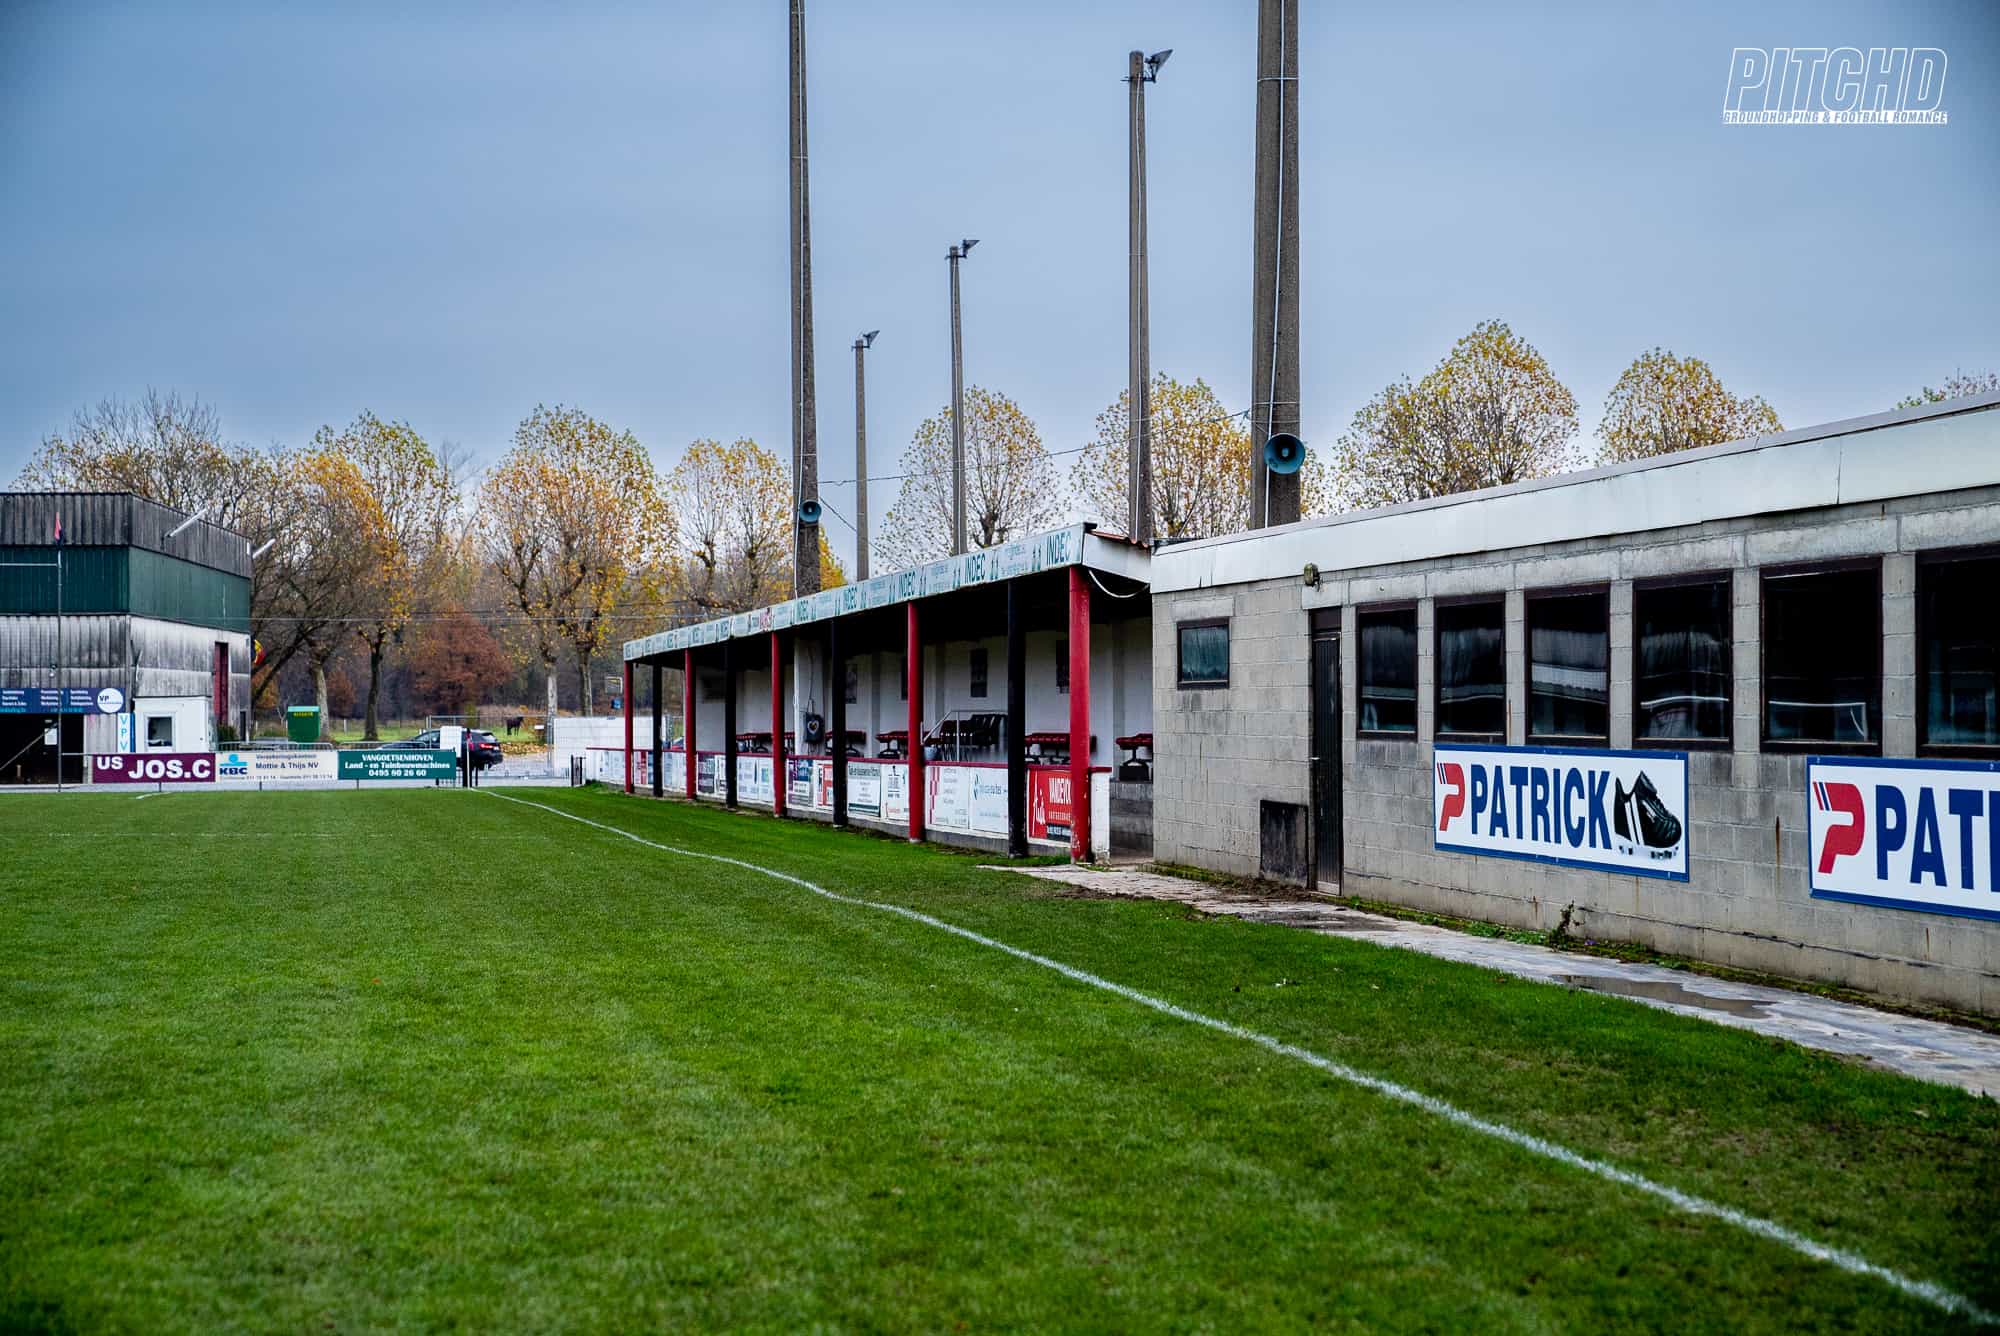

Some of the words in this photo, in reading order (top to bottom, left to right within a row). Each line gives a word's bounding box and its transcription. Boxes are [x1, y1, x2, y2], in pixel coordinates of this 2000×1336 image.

[97, 756, 124, 770] US
[128, 759, 211, 779] JOS.C
[219, 767, 248, 776] KBC
[307, 761, 319, 769] NV
[344, 761, 364, 769] Land
[381, 761, 450, 769] Tuinbouwmachines
[1470, 763, 1612, 850] PATRICK
[1876, 784, 2000, 893] PAT
